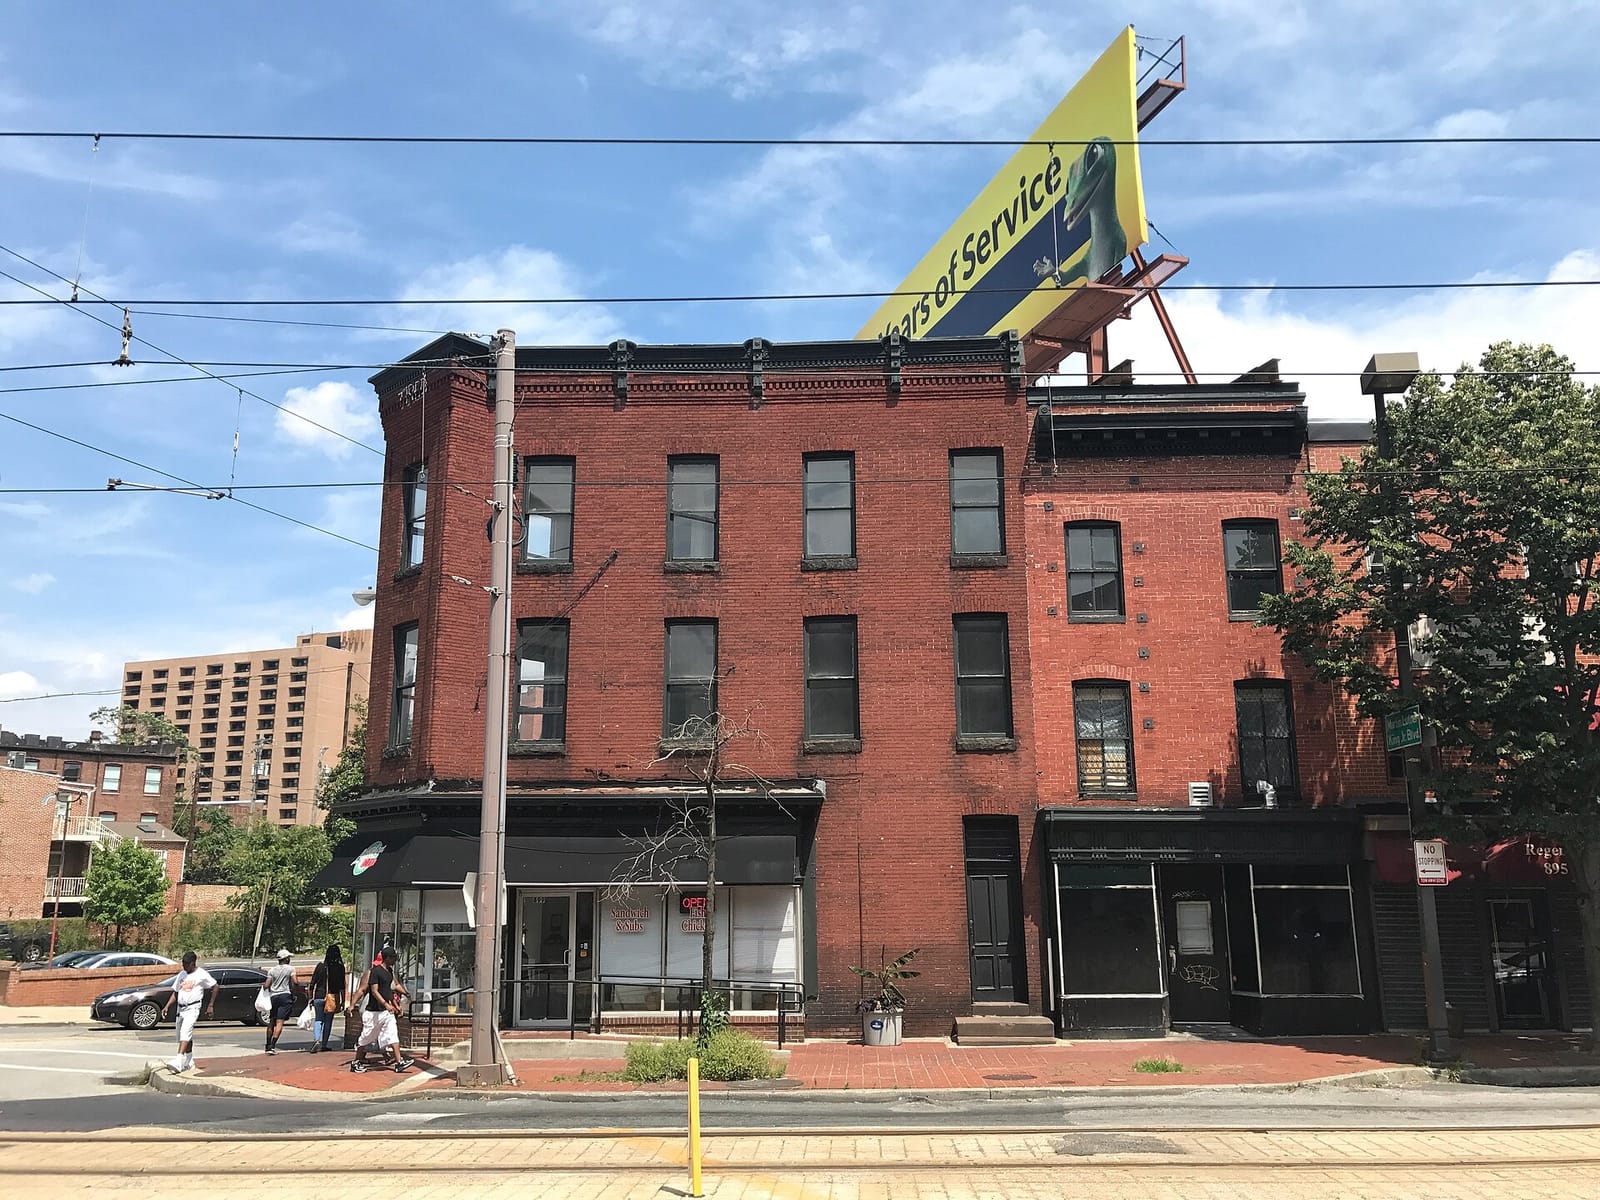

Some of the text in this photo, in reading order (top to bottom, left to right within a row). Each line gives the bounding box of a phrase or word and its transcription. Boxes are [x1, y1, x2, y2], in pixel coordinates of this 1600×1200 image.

[935, 249, 958, 308] of
[962, 156, 1062, 280] Service
[1423, 845, 1436, 854] NO
[1418, 857, 1443, 865] STOPPING
[1543, 862, 1569, 875] 895
[611, 905, 649, 919] Sandwich
[625, 919, 645, 933] Subs
[681, 919, 706, 933] Chick
